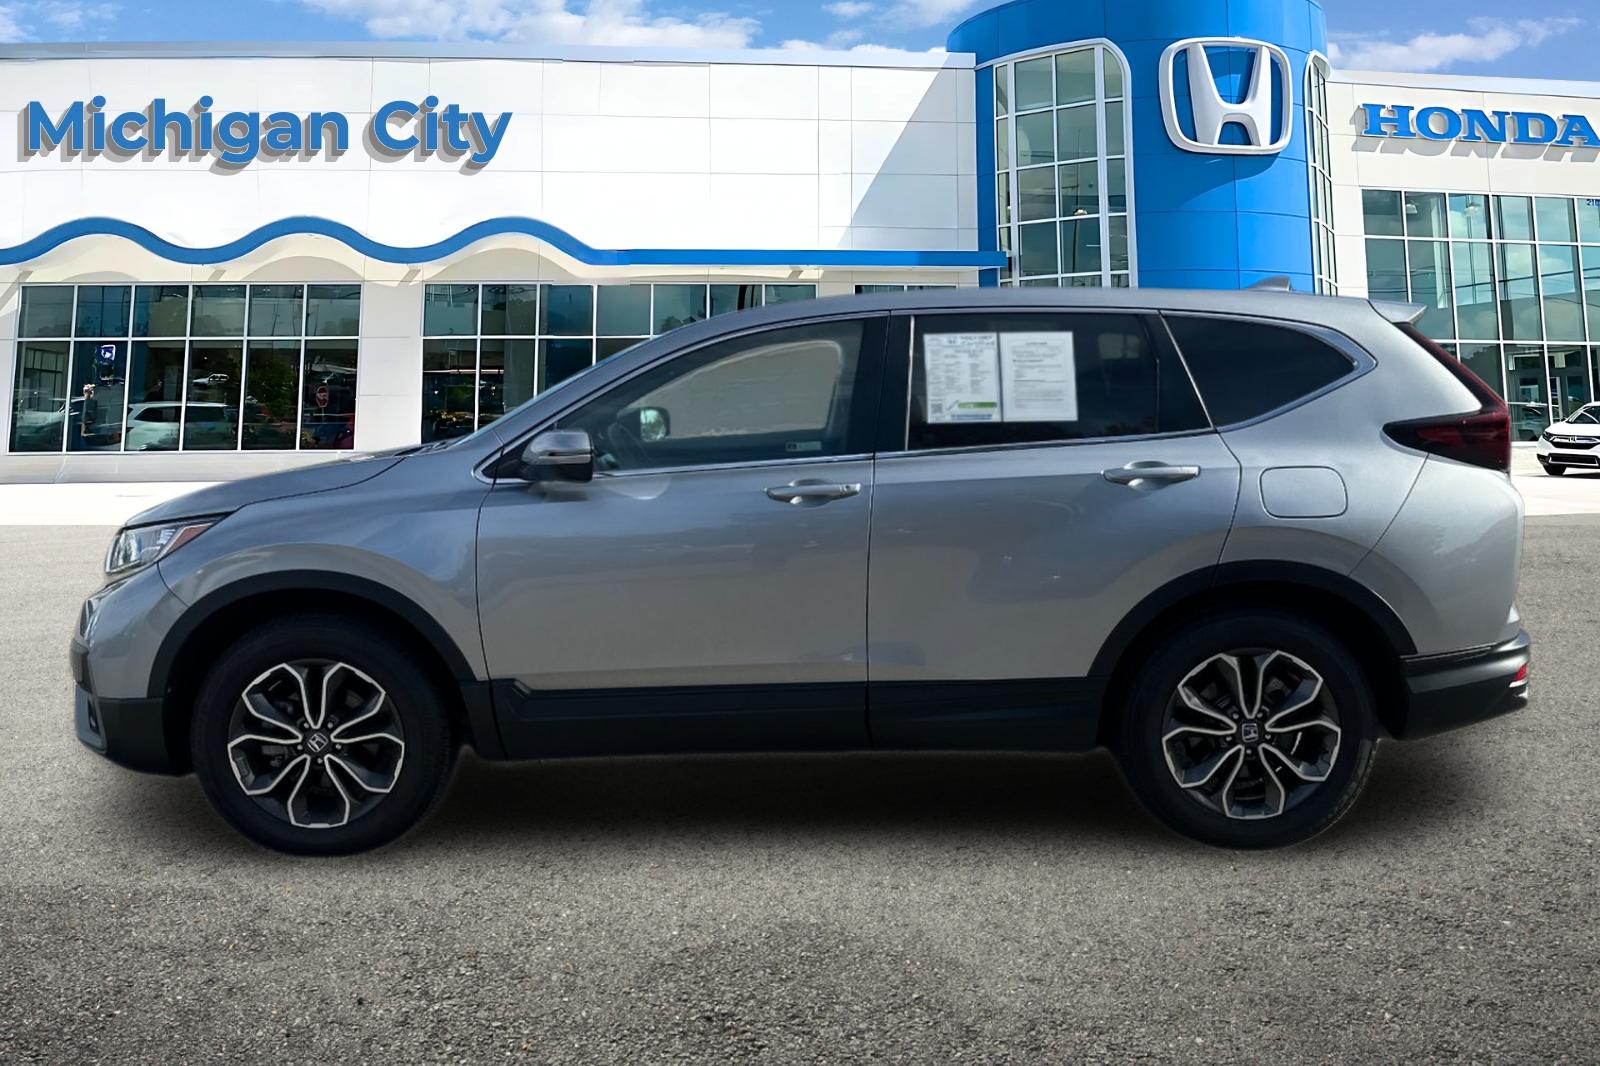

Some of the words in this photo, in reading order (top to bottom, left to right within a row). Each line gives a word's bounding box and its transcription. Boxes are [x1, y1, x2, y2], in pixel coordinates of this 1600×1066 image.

[28, 95, 349, 164] Michigan
[373, 95, 513, 164] City
[1361, 103, 1600, 147] HONDA
